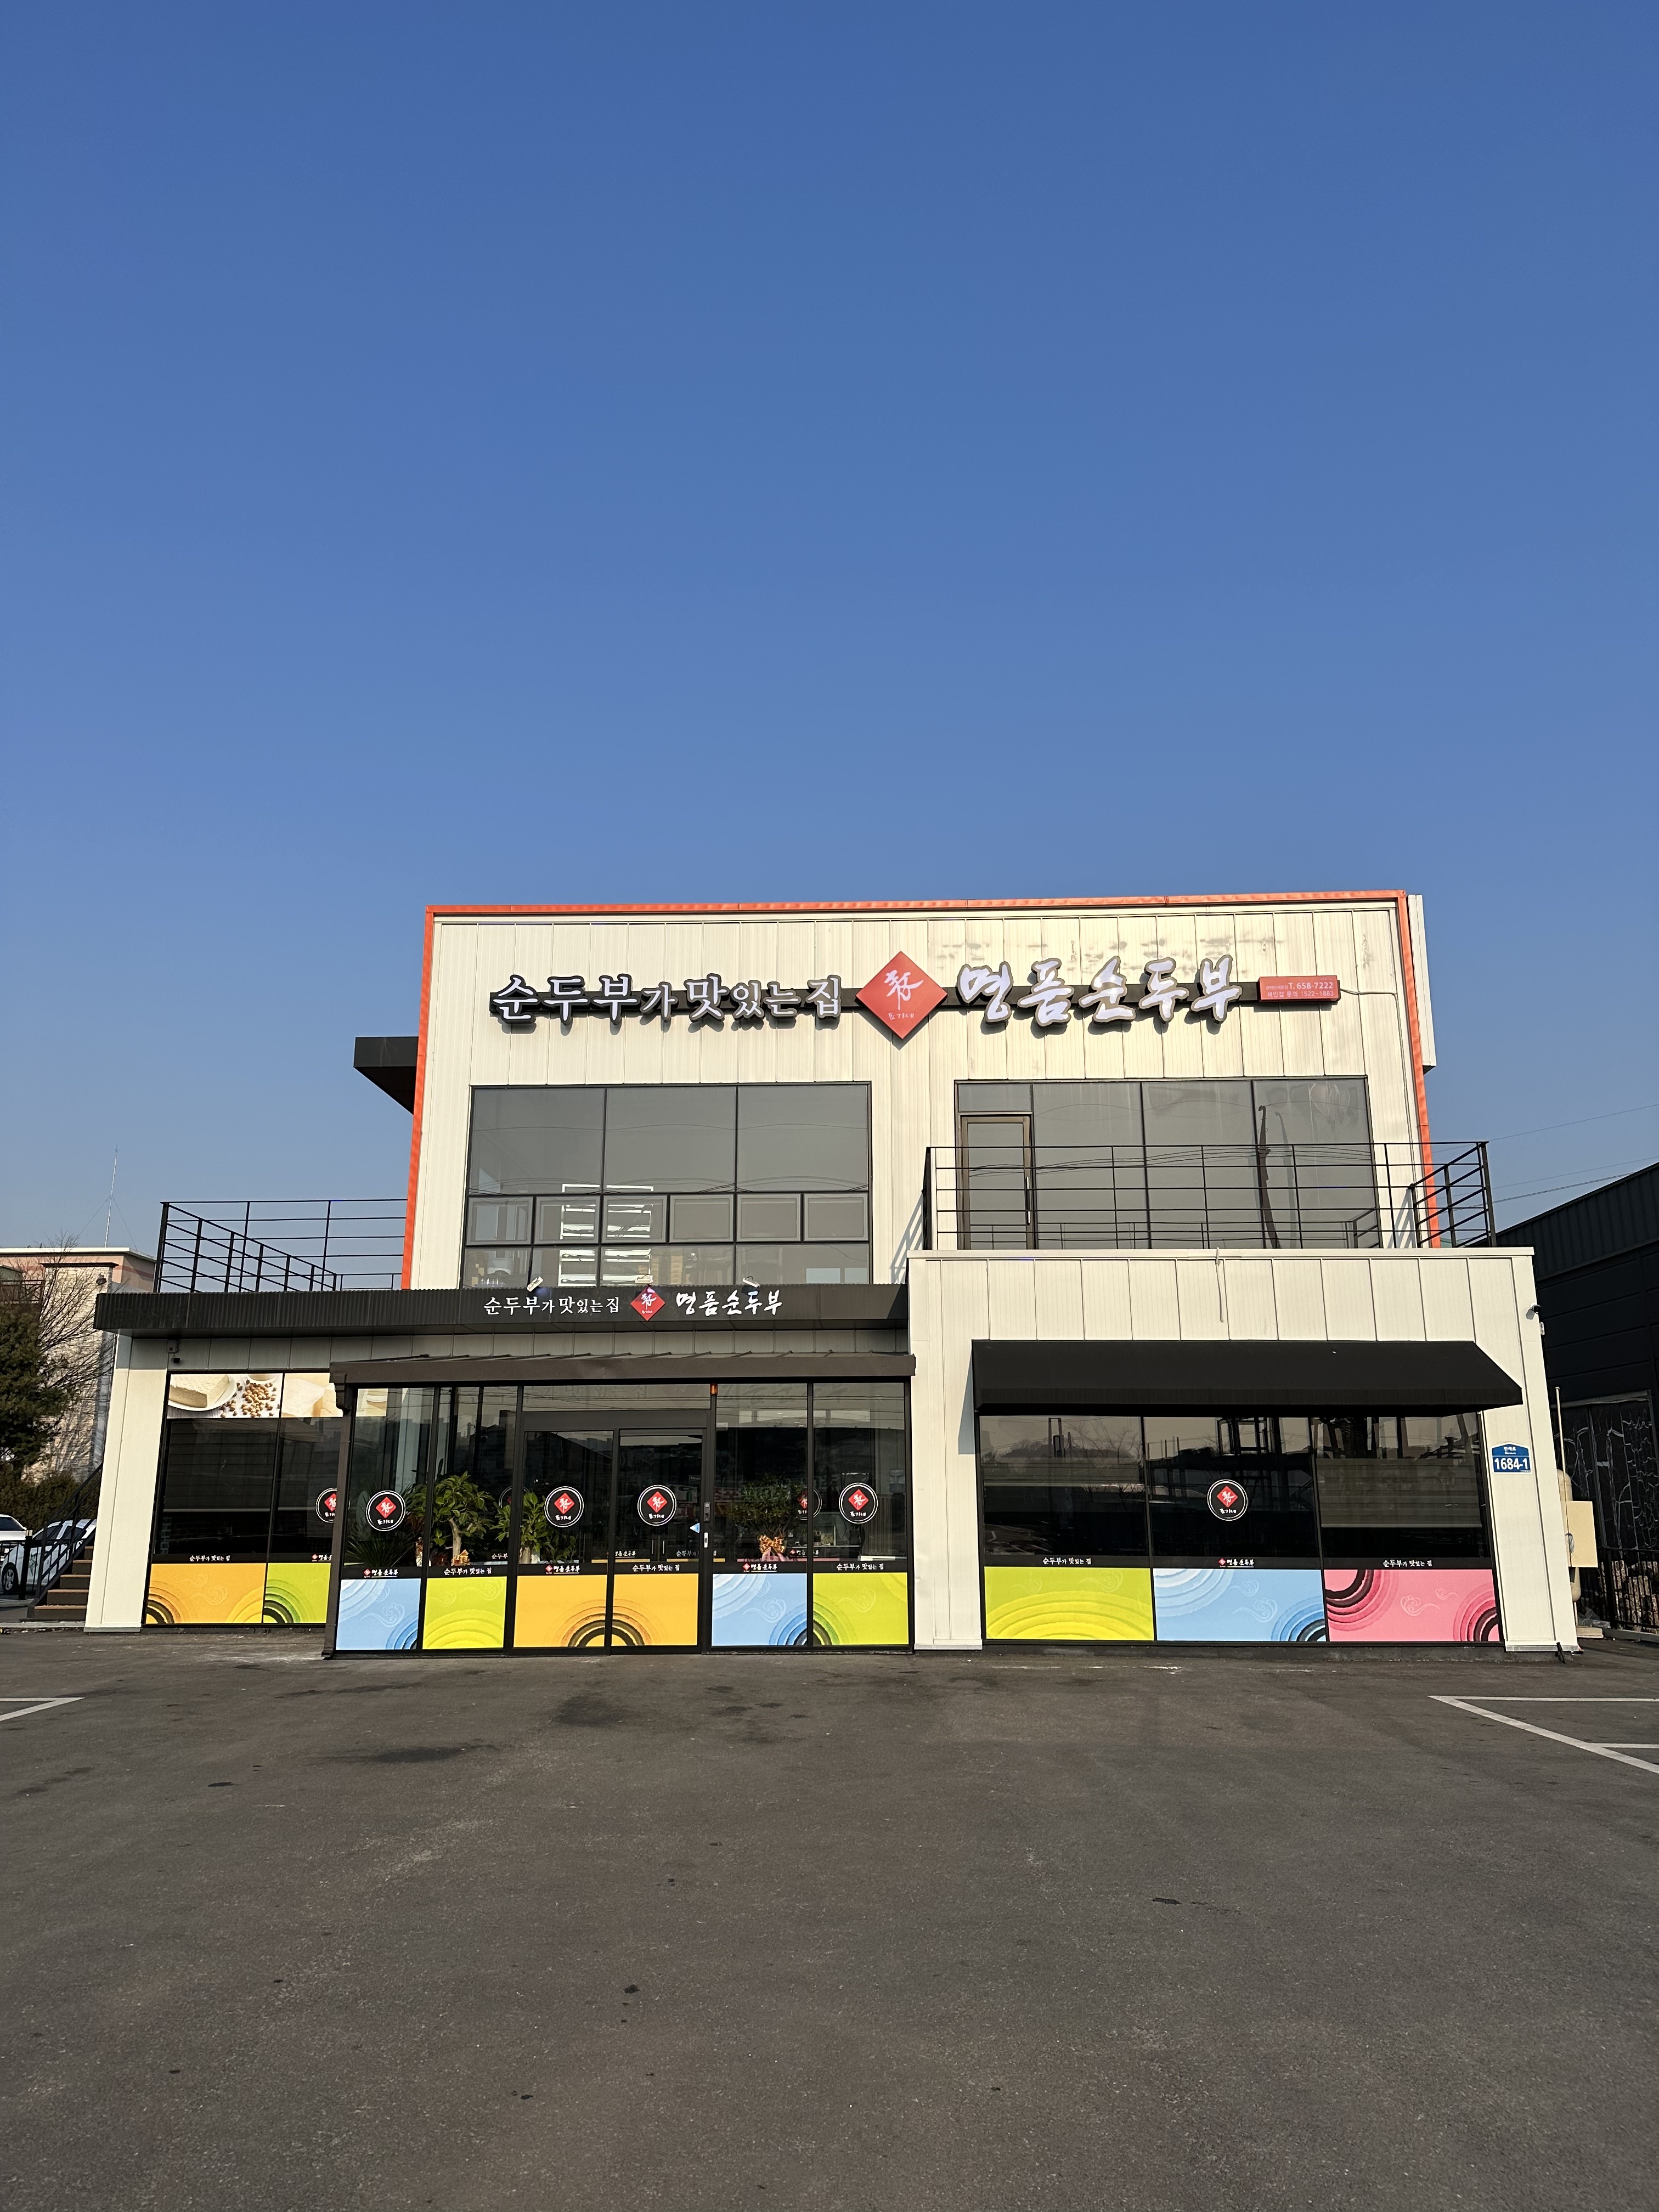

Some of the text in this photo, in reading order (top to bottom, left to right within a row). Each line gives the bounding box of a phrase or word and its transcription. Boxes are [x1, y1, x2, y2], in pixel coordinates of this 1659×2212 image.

[494, 975, 841, 1023] 순두부가 맛있는 집
[959, 956, 1241, 1025] 명품순두부
[483, 1296, 619, 1316] 순두부가 맛있는 집
[676, 1290, 783, 1316] 명품순두부
[1494, 1458, 1528, 1470] 1684-1
